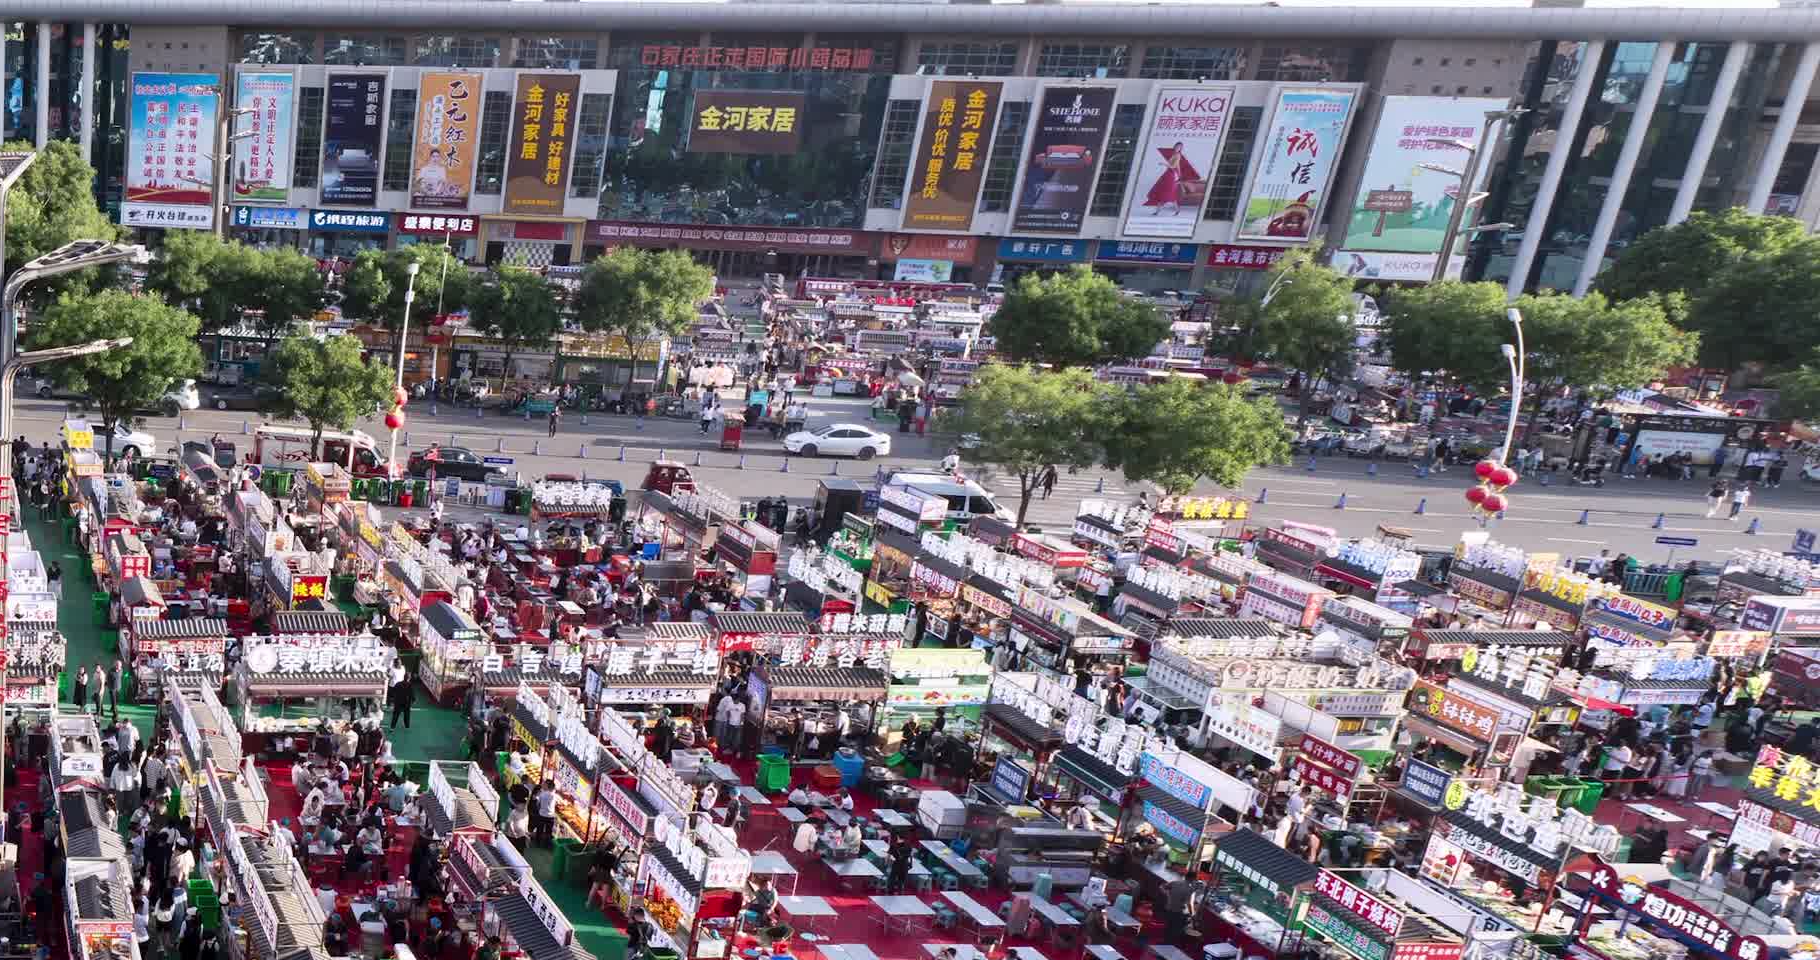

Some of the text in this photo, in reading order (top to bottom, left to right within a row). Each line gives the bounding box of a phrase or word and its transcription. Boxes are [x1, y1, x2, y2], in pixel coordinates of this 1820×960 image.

[641, 46, 875, 69] 石家庄正定国际小商品城
[520, 84, 545, 160] 金河家居
[698, 105, 796, 133] 金河家居
[952, 89, 988, 171] 金河家居
[1155, 116, 1221, 131] 顾家家居
[544, 92, 570, 185] 好家具 好建材
[931, 128, 949, 156] 价优
[1286, 128, 1318, 184] 诚信
[326, 214, 384, 226] 携程旅游
[1592, 869, 1611, 888] 火
[1315, 873, 1404, 938] 东北刚子烧烤
